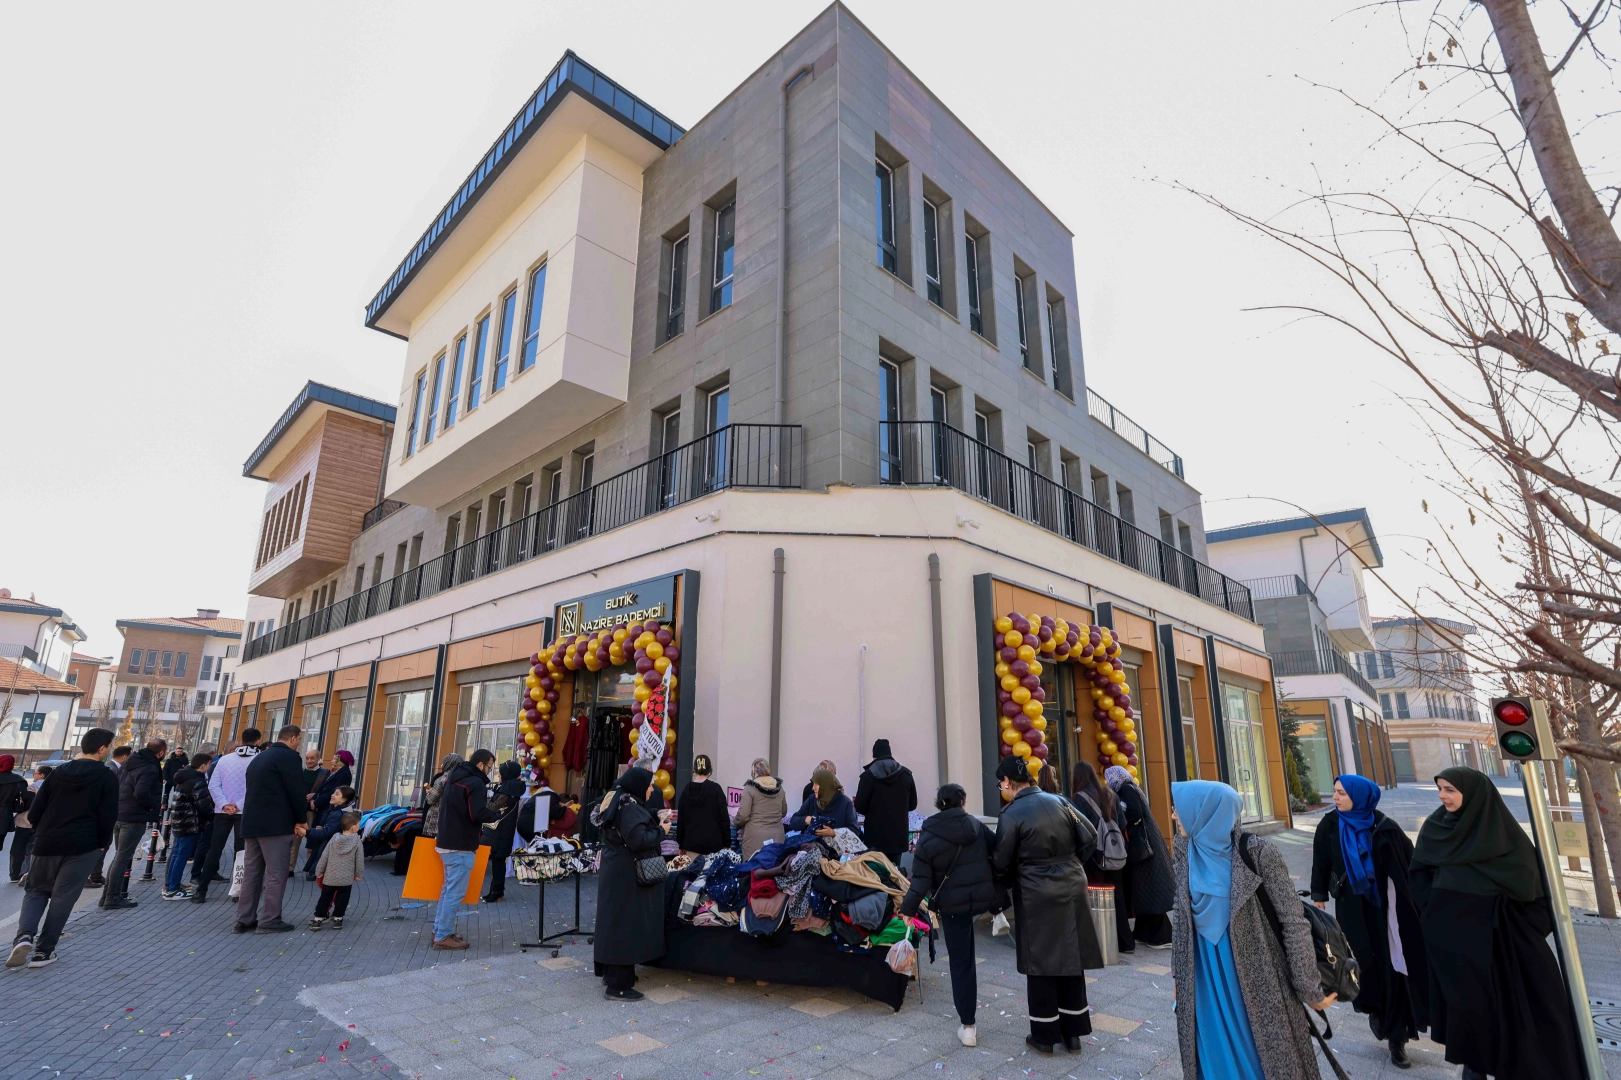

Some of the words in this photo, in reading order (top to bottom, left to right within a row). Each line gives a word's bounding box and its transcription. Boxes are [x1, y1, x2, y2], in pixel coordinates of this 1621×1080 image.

[605, 591, 635, 610] BUTİK
[580, 615, 613, 633] NAZİRE
[615, 602, 661, 625] BADEMCİ
[645, 731, 663, 755] TUTKU
